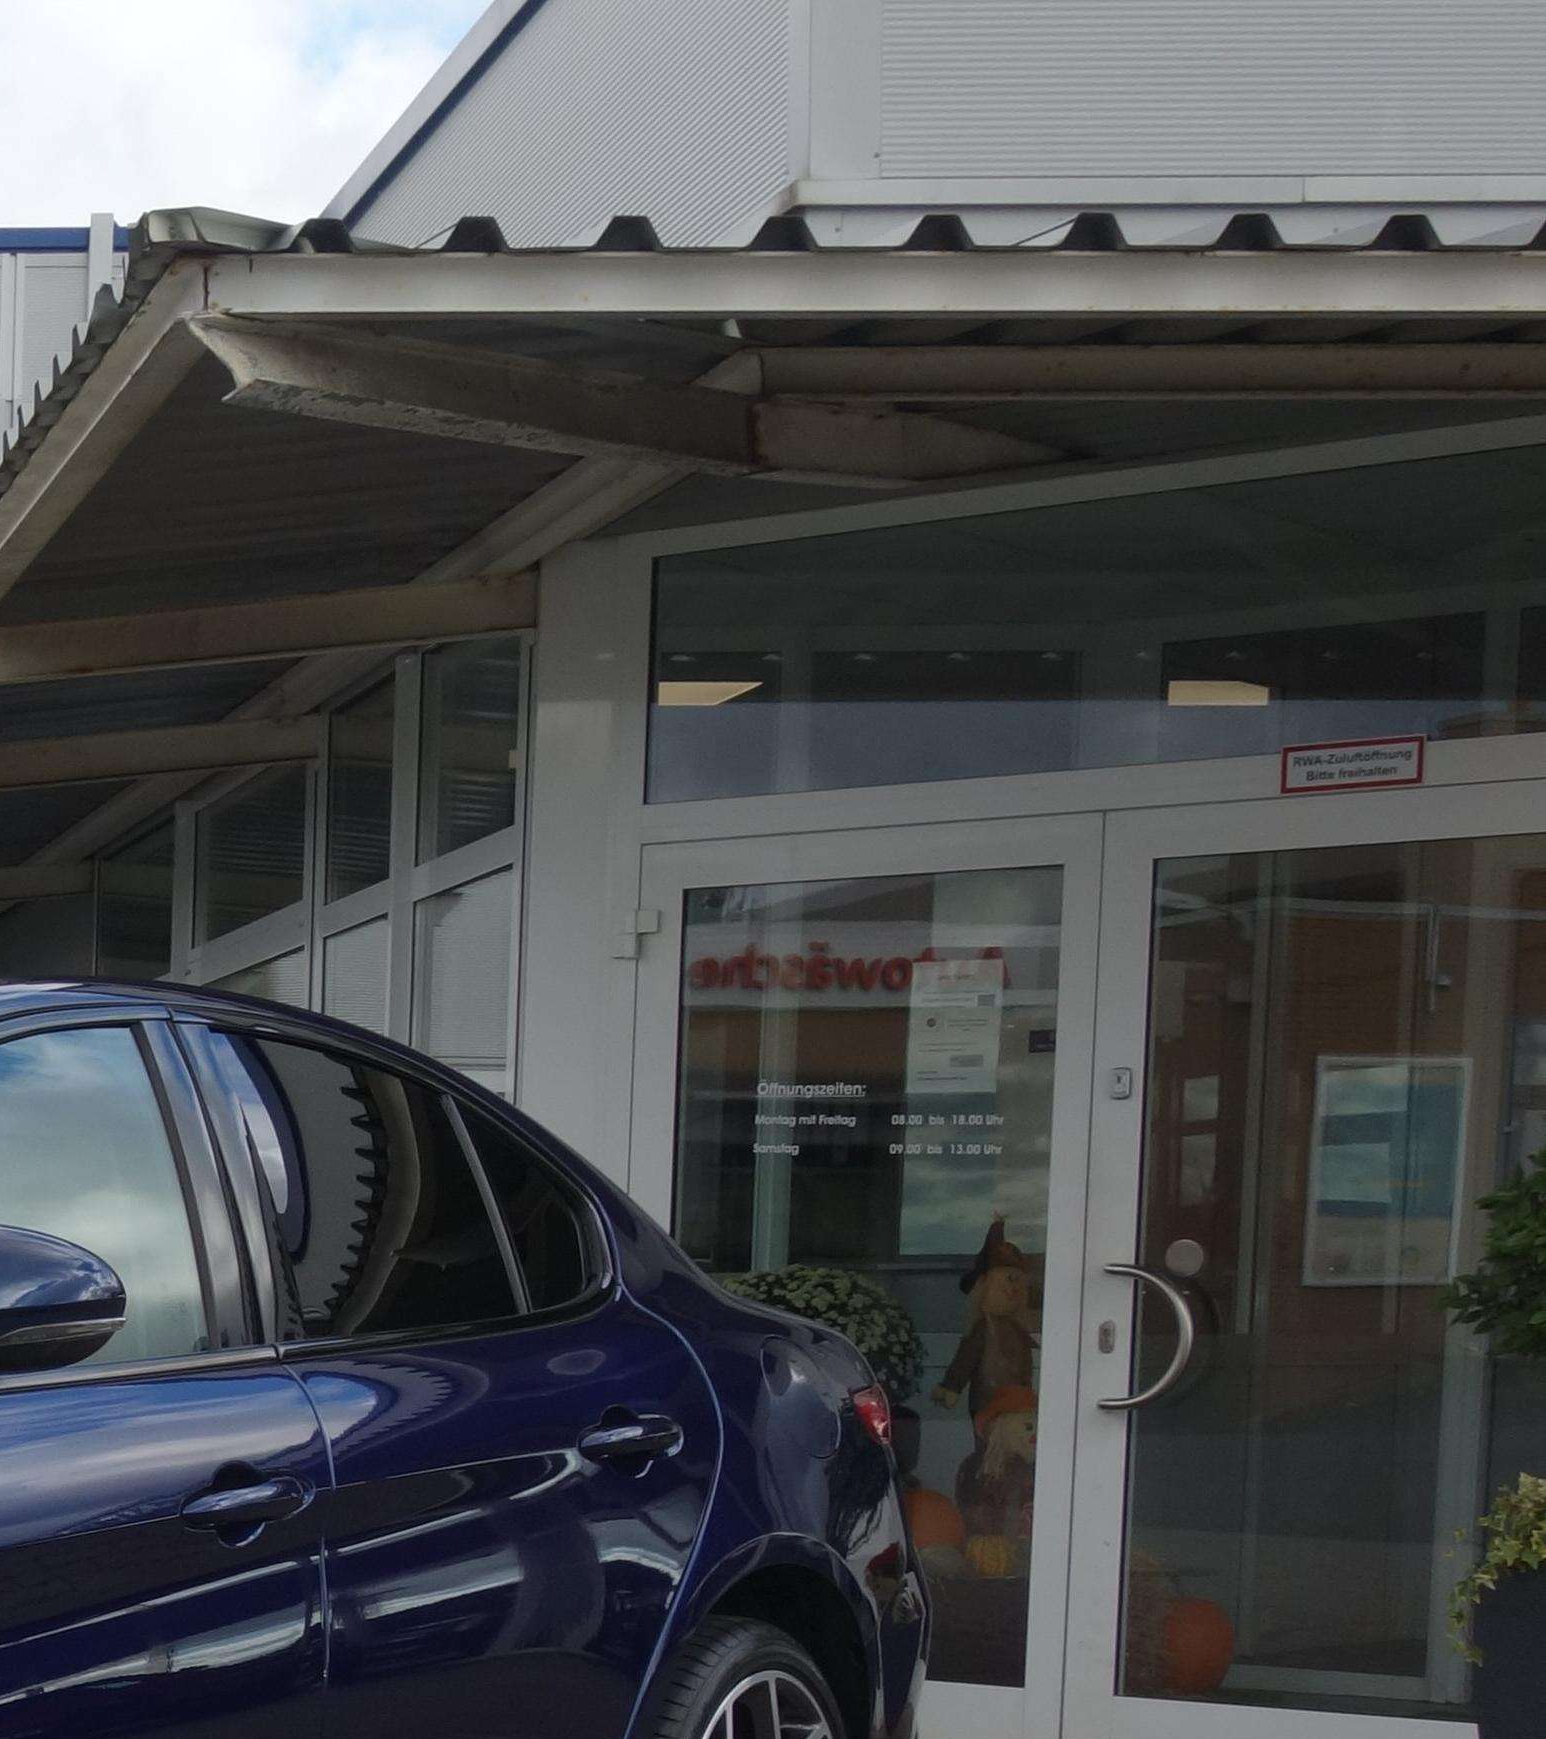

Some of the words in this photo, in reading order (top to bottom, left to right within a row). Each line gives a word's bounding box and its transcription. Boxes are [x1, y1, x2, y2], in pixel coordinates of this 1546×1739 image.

[1305, 769, 1335, 781] Bitte
[1338, 766, 1398, 779] freihalten
[756, 1080, 867, 1098] Öffnungszeiten:
[754, 1115, 797, 1127] Montag
[818, 1114, 857, 1127] Freitag
[928, 1114, 946, 1125] bis
[985, 1114, 1005, 1125] Uhr
[752, 1143, 800, 1156] Samstag
[926, 1144, 944, 1154] bis
[983, 1143, 1003, 1154] Uhr
